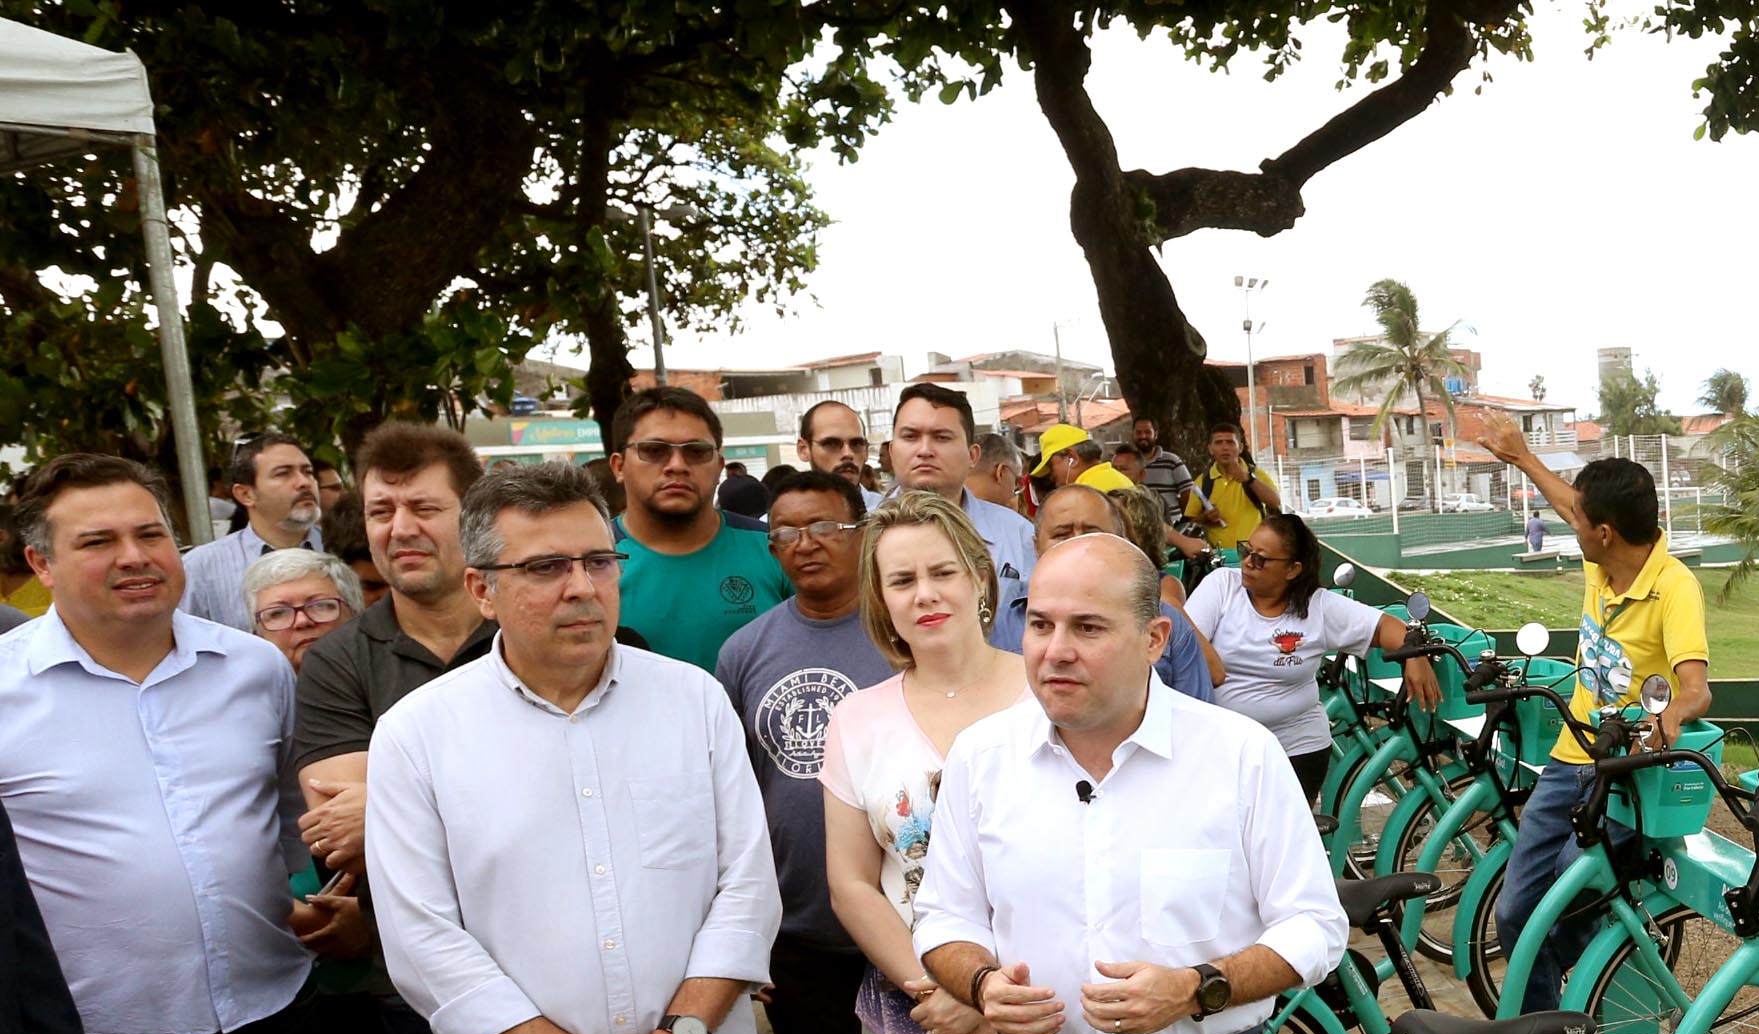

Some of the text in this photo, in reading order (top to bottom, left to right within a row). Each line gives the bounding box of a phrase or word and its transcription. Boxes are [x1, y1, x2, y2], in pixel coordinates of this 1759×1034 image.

[763, 673, 809, 711] MIAMI
[774, 683, 828, 711] ESTABLISHED
[798, 714, 805, 724] F
[1666, 863, 1676, 879] 09
